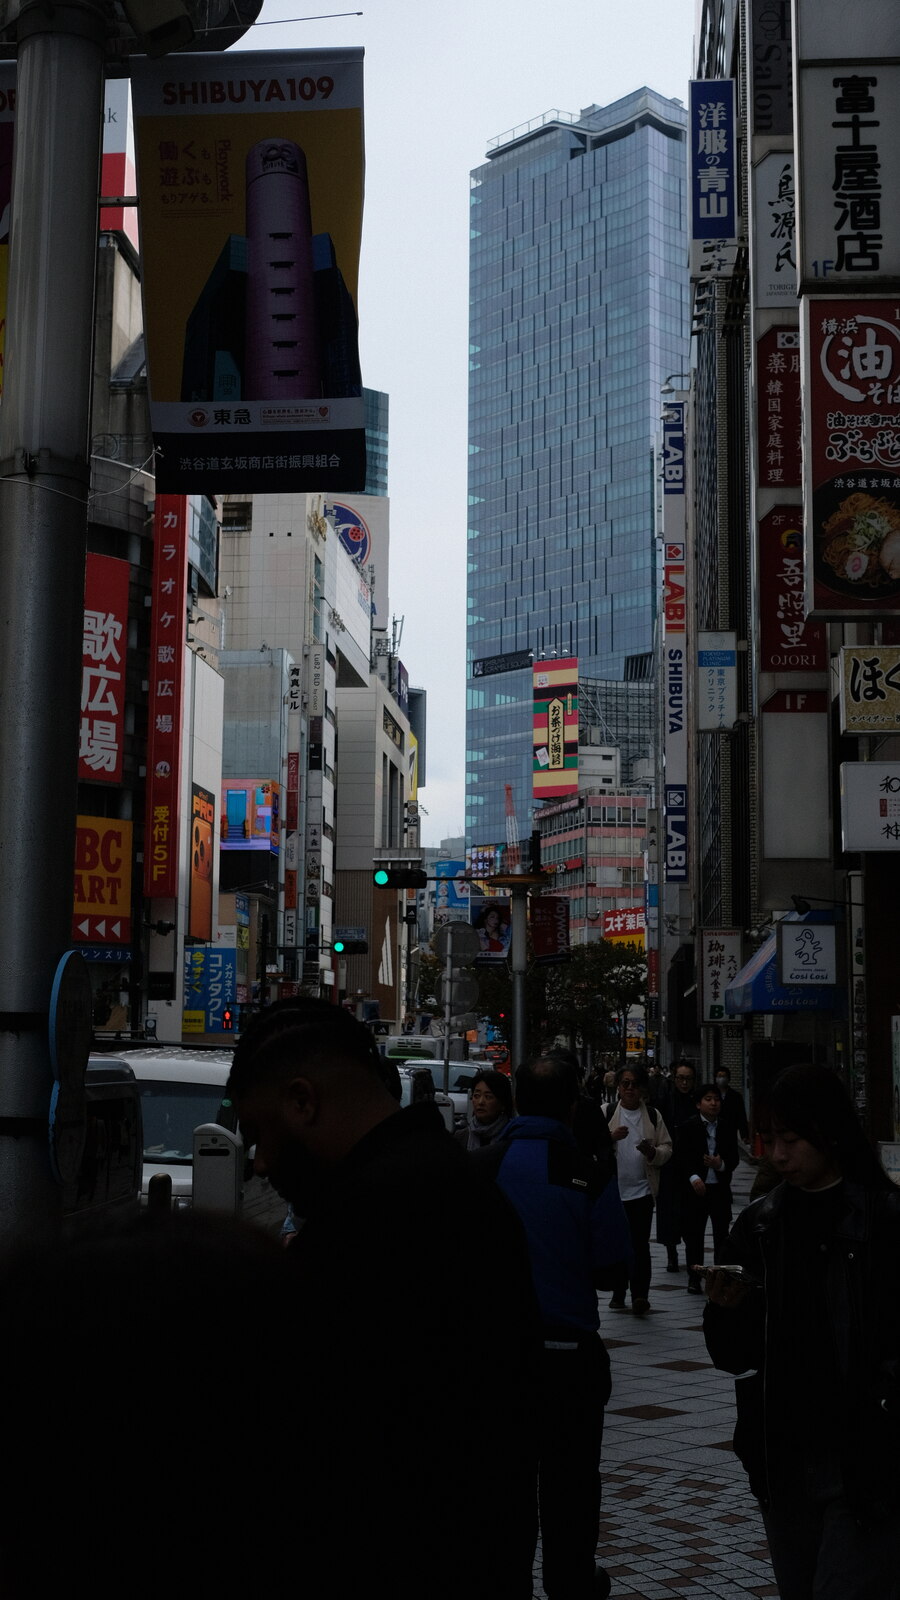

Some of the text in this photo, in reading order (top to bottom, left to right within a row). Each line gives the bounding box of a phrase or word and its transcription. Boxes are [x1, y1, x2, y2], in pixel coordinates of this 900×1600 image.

[162, 75, 335, 105] SHIBUYA109
[160, 167, 211, 186] 遊ぶも
[697, 101, 730, 219] 洋服の青山
[832, 75, 882, 272] 富士屋酒店
[812, 260, 834, 277] 1F
[820, 317, 859, 335] 横浜
[837, 327, 893, 381] 油
[213, 408, 252, 425] 東急
[765, 380, 784, 483] 韓国家庭料理
[178, 454, 342, 471] 渋谷道玄坂商店街振興組合
[665, 431, 684, 490] LABI
[155, 511, 178, 734] カラオケ歌広場
[665, 565, 685, 632] LABI
[776, 558, 807, 649] 吾照里
[770, 654, 817, 666] OJORI
[78, 608, 123, 773] 歌広場
[668, 648, 683, 735] SHIBUYA
[785, 694, 808, 710] 1F
[193, 794, 214, 823] PRO
[152, 806, 170, 882] 受付5F
[666, 813, 687, 878] LABI
[604, 912, 646, 932] スギ薬局
[192, 951, 206, 993] 今すぐ
[708, 940, 725, 968] 珈琲
[208, 954, 222, 1027] コンタクト
